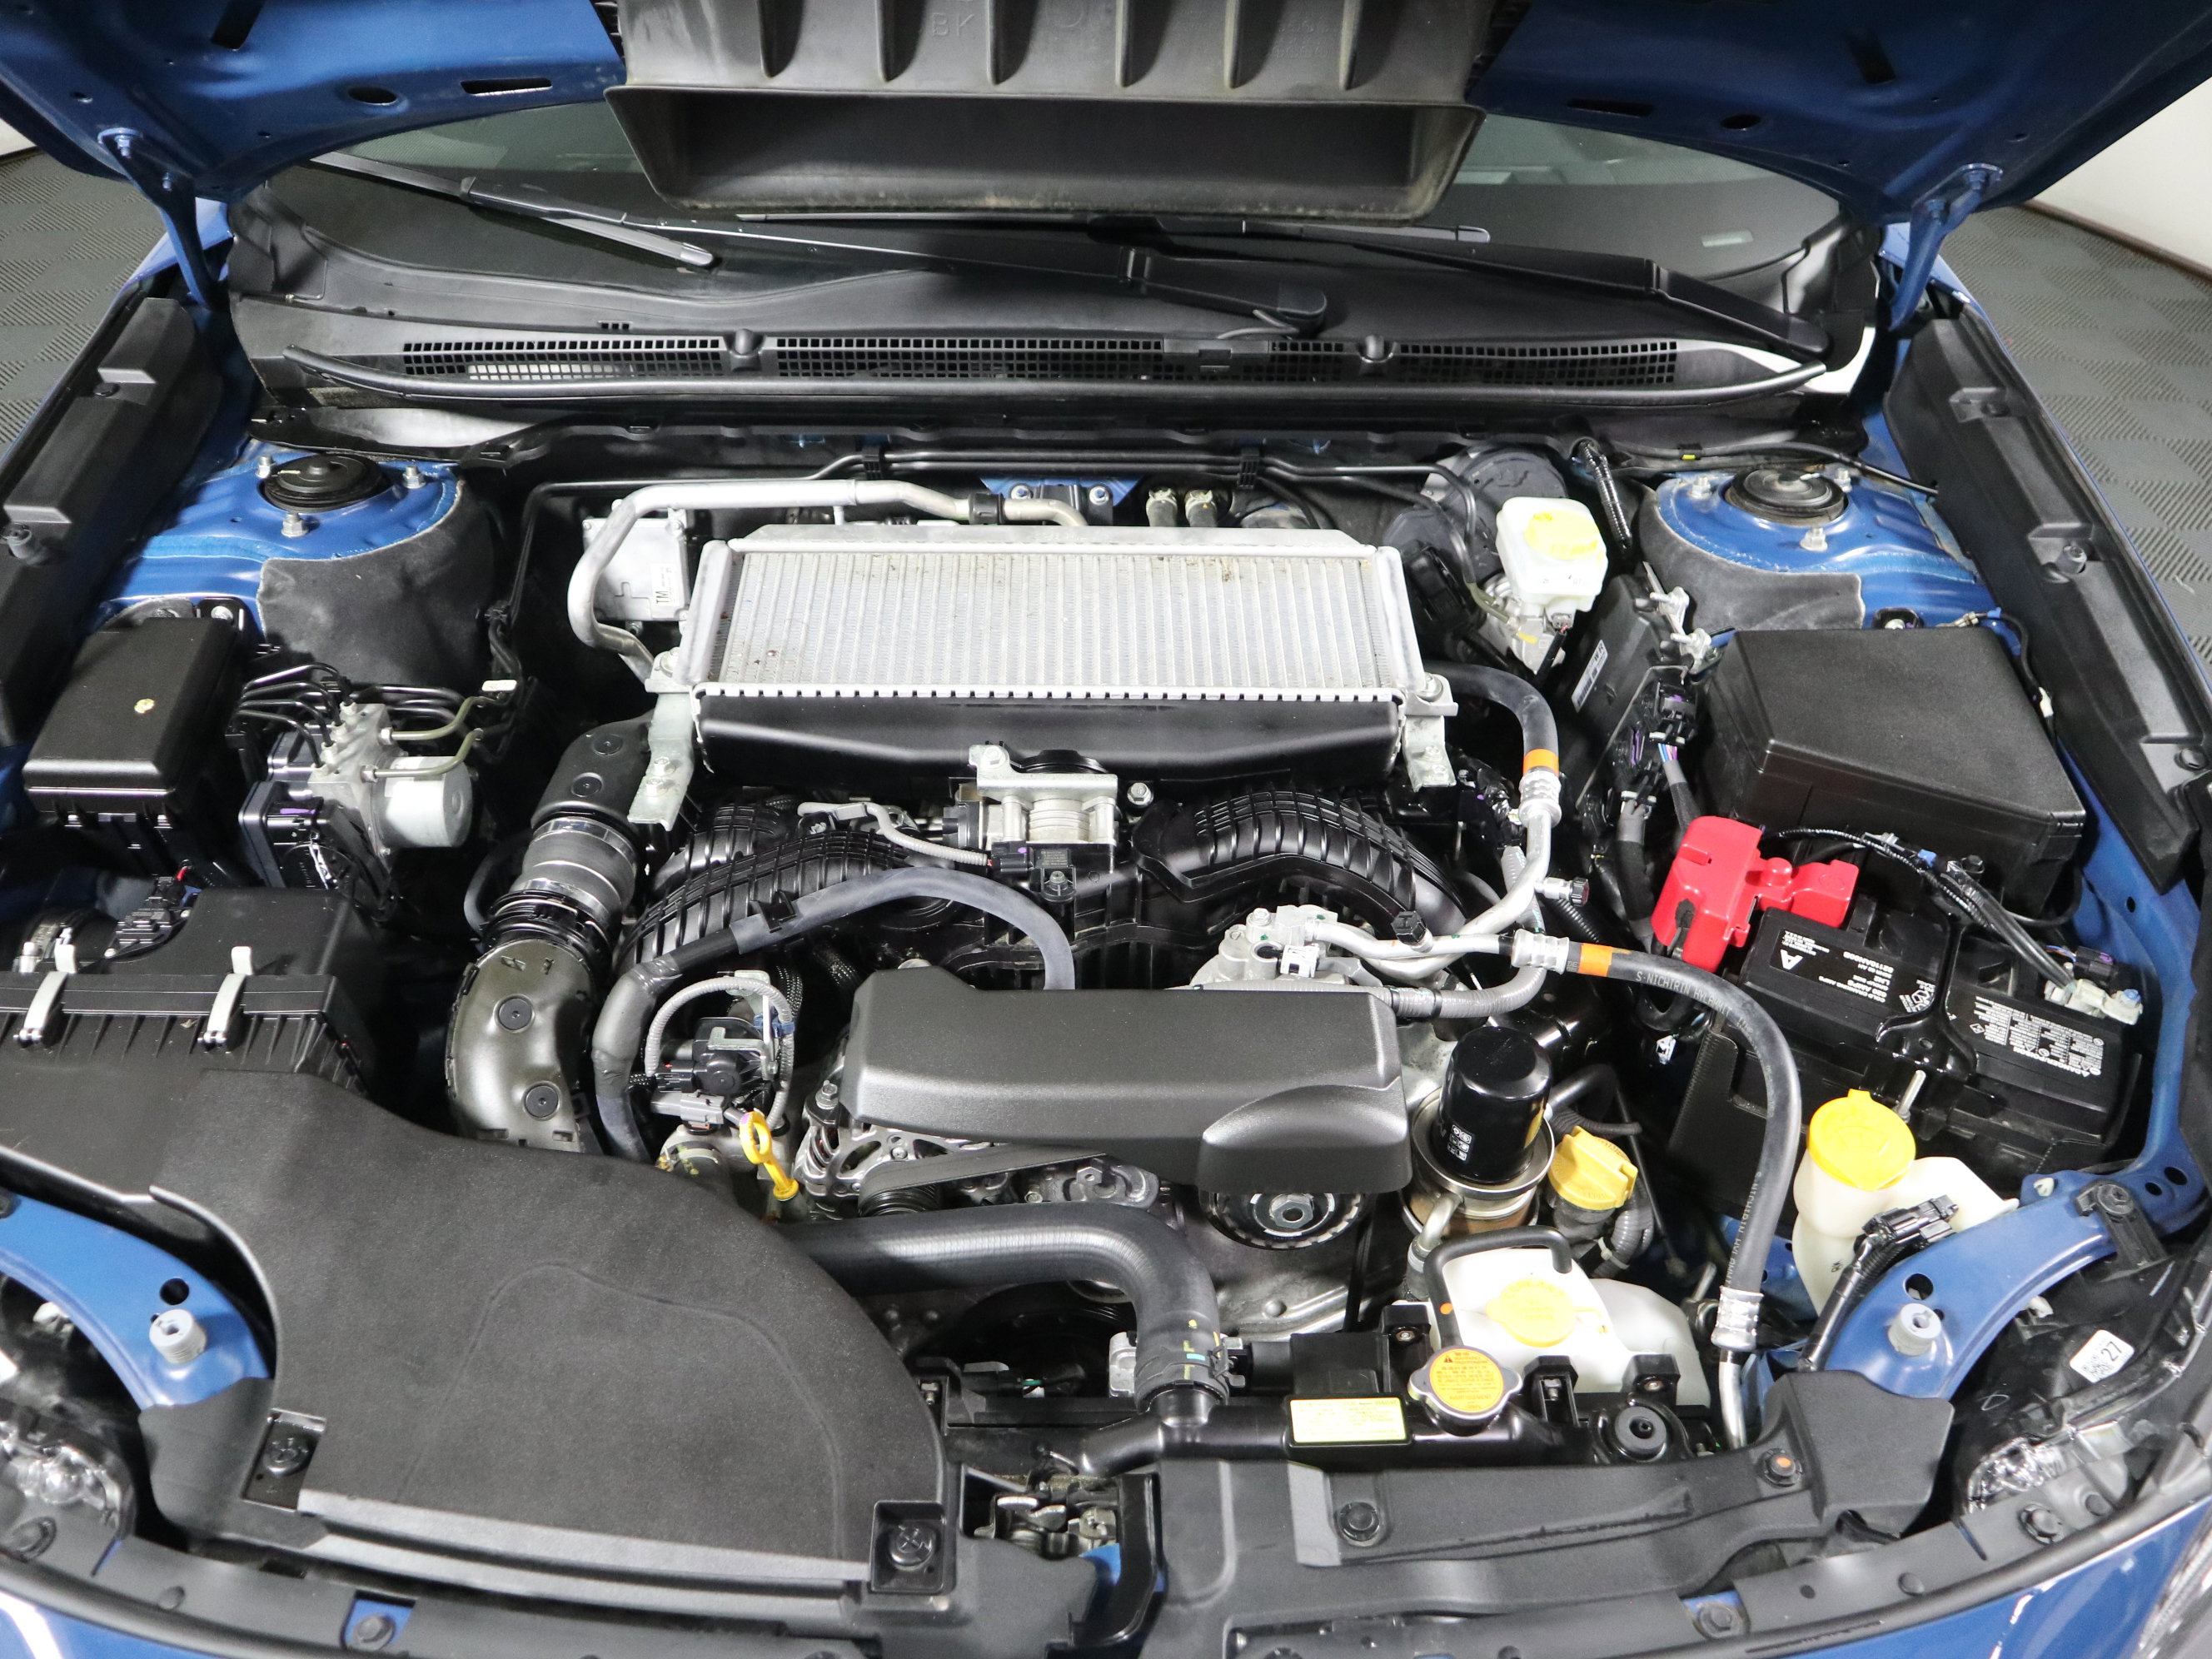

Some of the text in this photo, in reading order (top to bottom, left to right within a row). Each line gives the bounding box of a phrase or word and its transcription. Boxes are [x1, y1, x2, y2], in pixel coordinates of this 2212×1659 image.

[932, 12, 974, 37] BK
[655, 590, 670, 603] TM
[2099, 1339, 2122, 1363] 27
